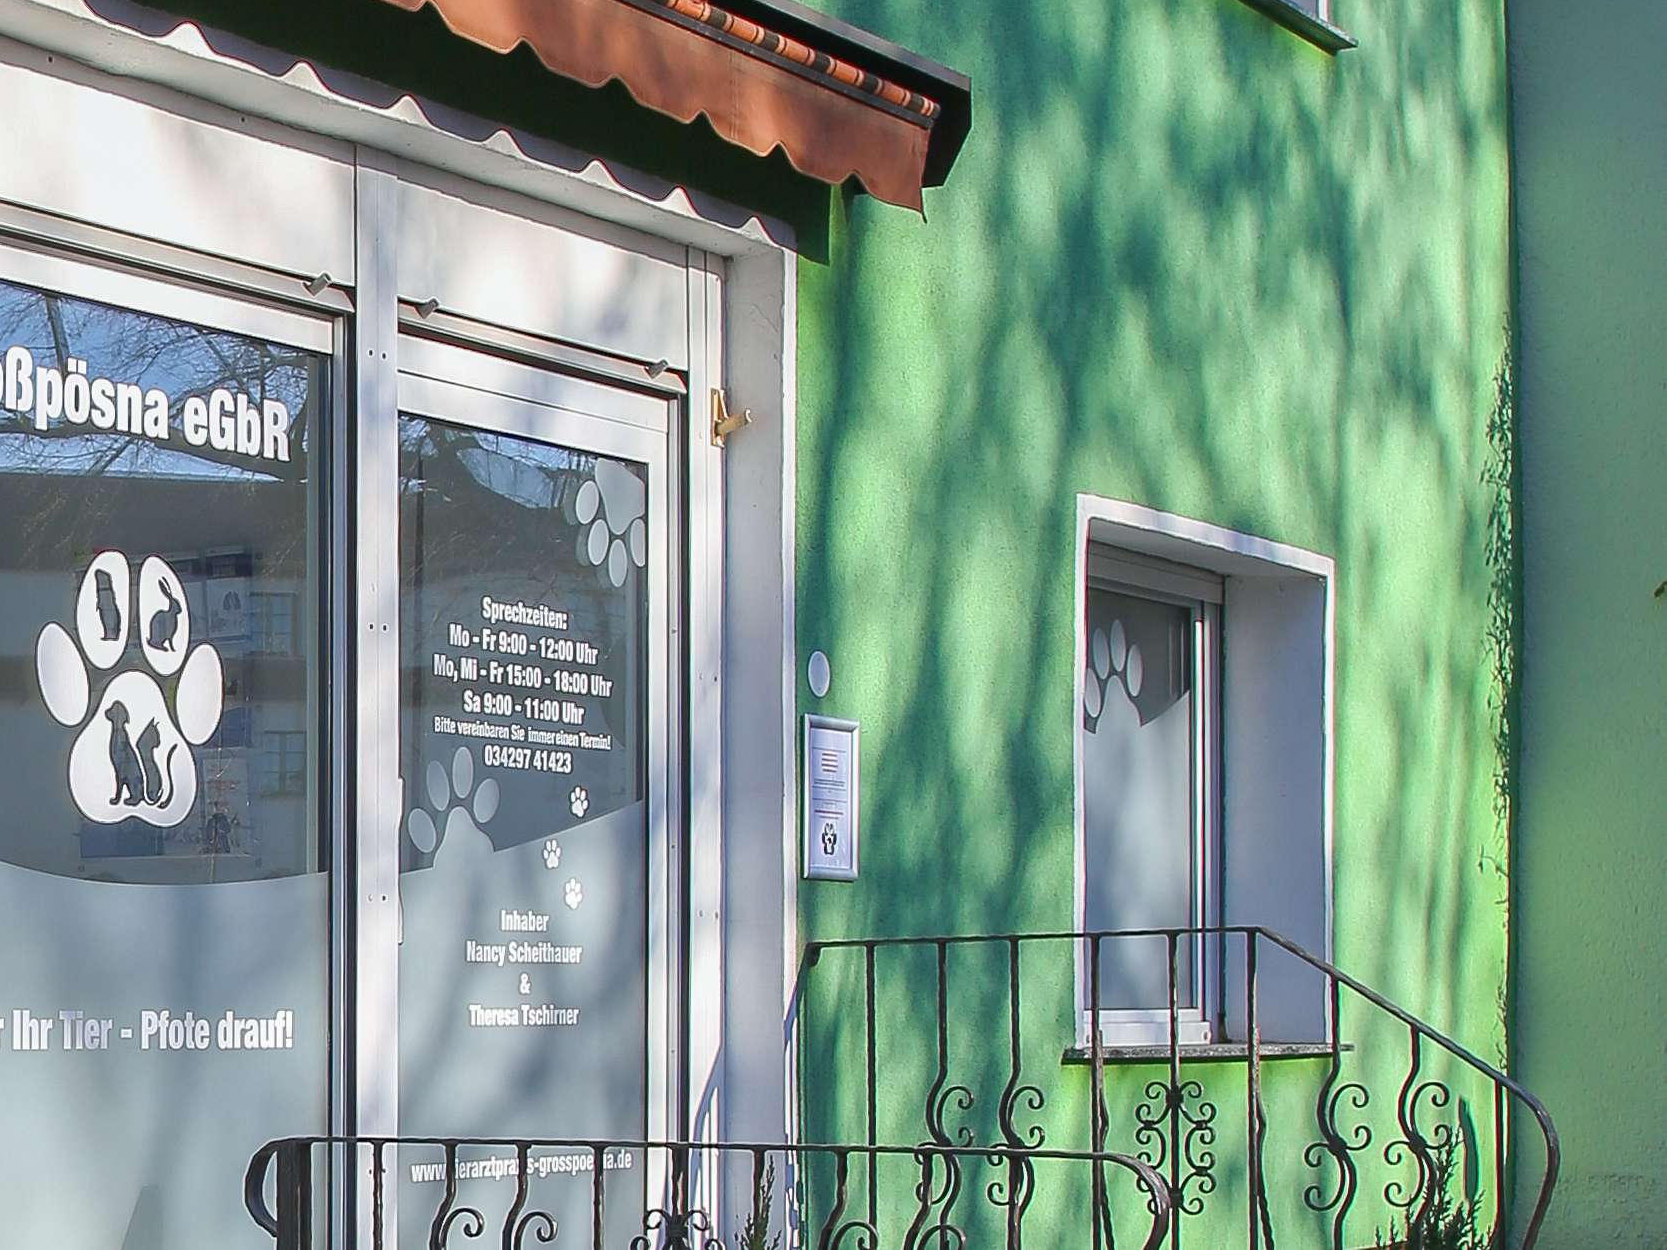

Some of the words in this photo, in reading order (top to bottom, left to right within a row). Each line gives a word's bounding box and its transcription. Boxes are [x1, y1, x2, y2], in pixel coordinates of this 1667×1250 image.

[183, 388, 291, 463] eGbR
[482, 596, 569, 631] Sprechzeiten:
[449, 623, 470, 647] Mo
[482, 628, 497, 652] Fr
[499, 631, 527, 655] 9:00
[539, 637, 574, 661] 12:00
[576, 641, 599, 666] Uhr
[433, 653, 459, 682] Mo,
[460, 657, 478, 681] Mi
[489, 661, 506, 684] Fr
[506, 664, 542, 689] 15:00
[553, 670, 588, 695] 18:00
[590, 674, 613, 698] Uhr
[463, 689, 481, 714] Sa
[483, 693, 512, 717] 9:00
[524, 697, 560, 723] 11:00
[562, 701, 584, 725] Uhr
[434, 717, 456, 735] Bitte
[457, 721, 509, 740] vereinbaren
[511, 724, 525, 742] Sie
[528, 727, 556, 746] immer
[556, 731, 579, 748] einen
[580, 733, 612, 751] Termin!
[484, 744, 531, 770] 034297
[533, 750, 572, 774] 41423
[500, 909, 549, 932] Inhaber
[466, 940, 506, 967] Nancy
[508, 941, 583, 964] Scheithauer
[519, 972, 531, 994] &
[11, 1008, 54, 1050] Ihr
[59, 1009, 113, 1050] Tier
[140, 1009, 210, 1051] Pfote
[217, 1009, 294, 1050] drauf!
[468, 1004, 519, 1027] Theresa
[521, 1003, 579, 1026] Tschirner
